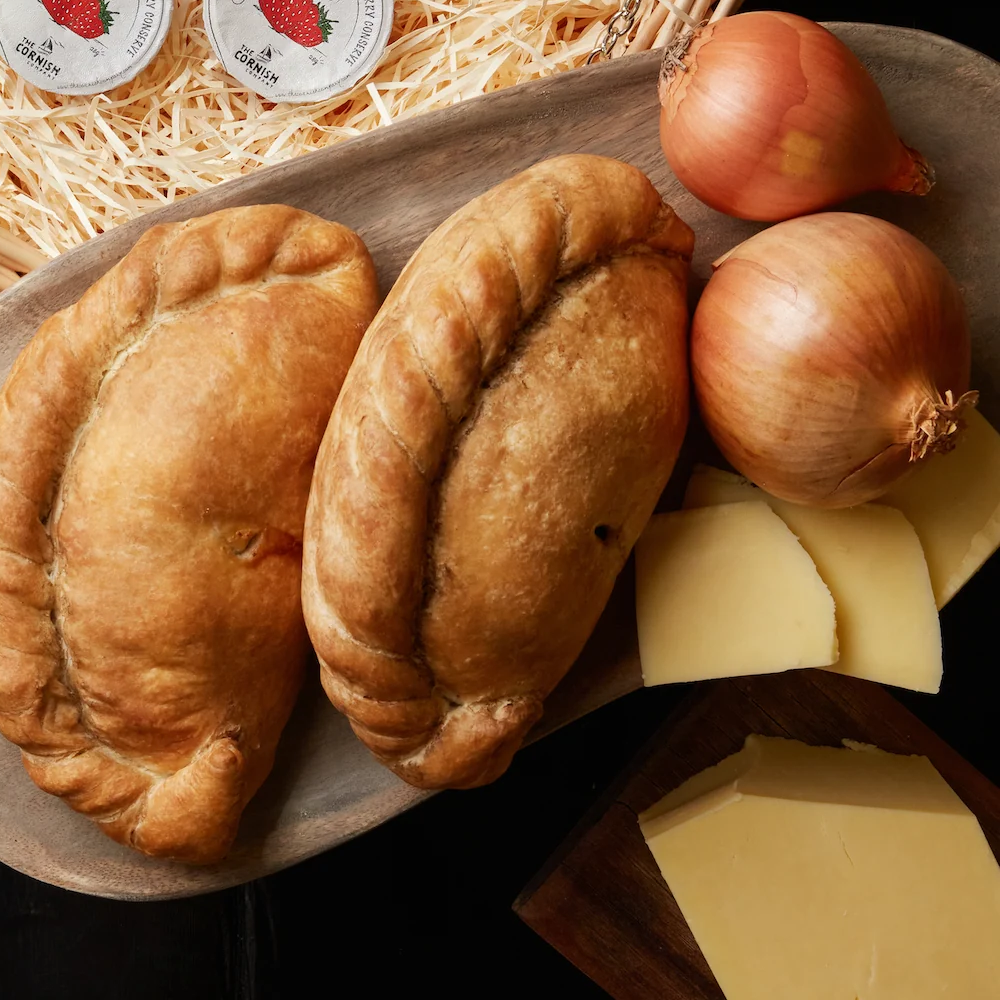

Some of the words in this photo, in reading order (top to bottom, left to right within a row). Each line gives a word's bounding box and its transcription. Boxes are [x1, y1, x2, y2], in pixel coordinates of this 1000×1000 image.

[22, 37, 36, 48] THE
[128, 12, 154, 58] CONSERVE
[345, 22, 374, 66] CONSERVE
[16, 43, 61, 76] CORNISH
[240, 44, 254, 56] THE
[26, 60, 56, 80] COMPANY
[234, 50, 280, 84] CORNISH
[246, 69, 274, 88] COMPANY
